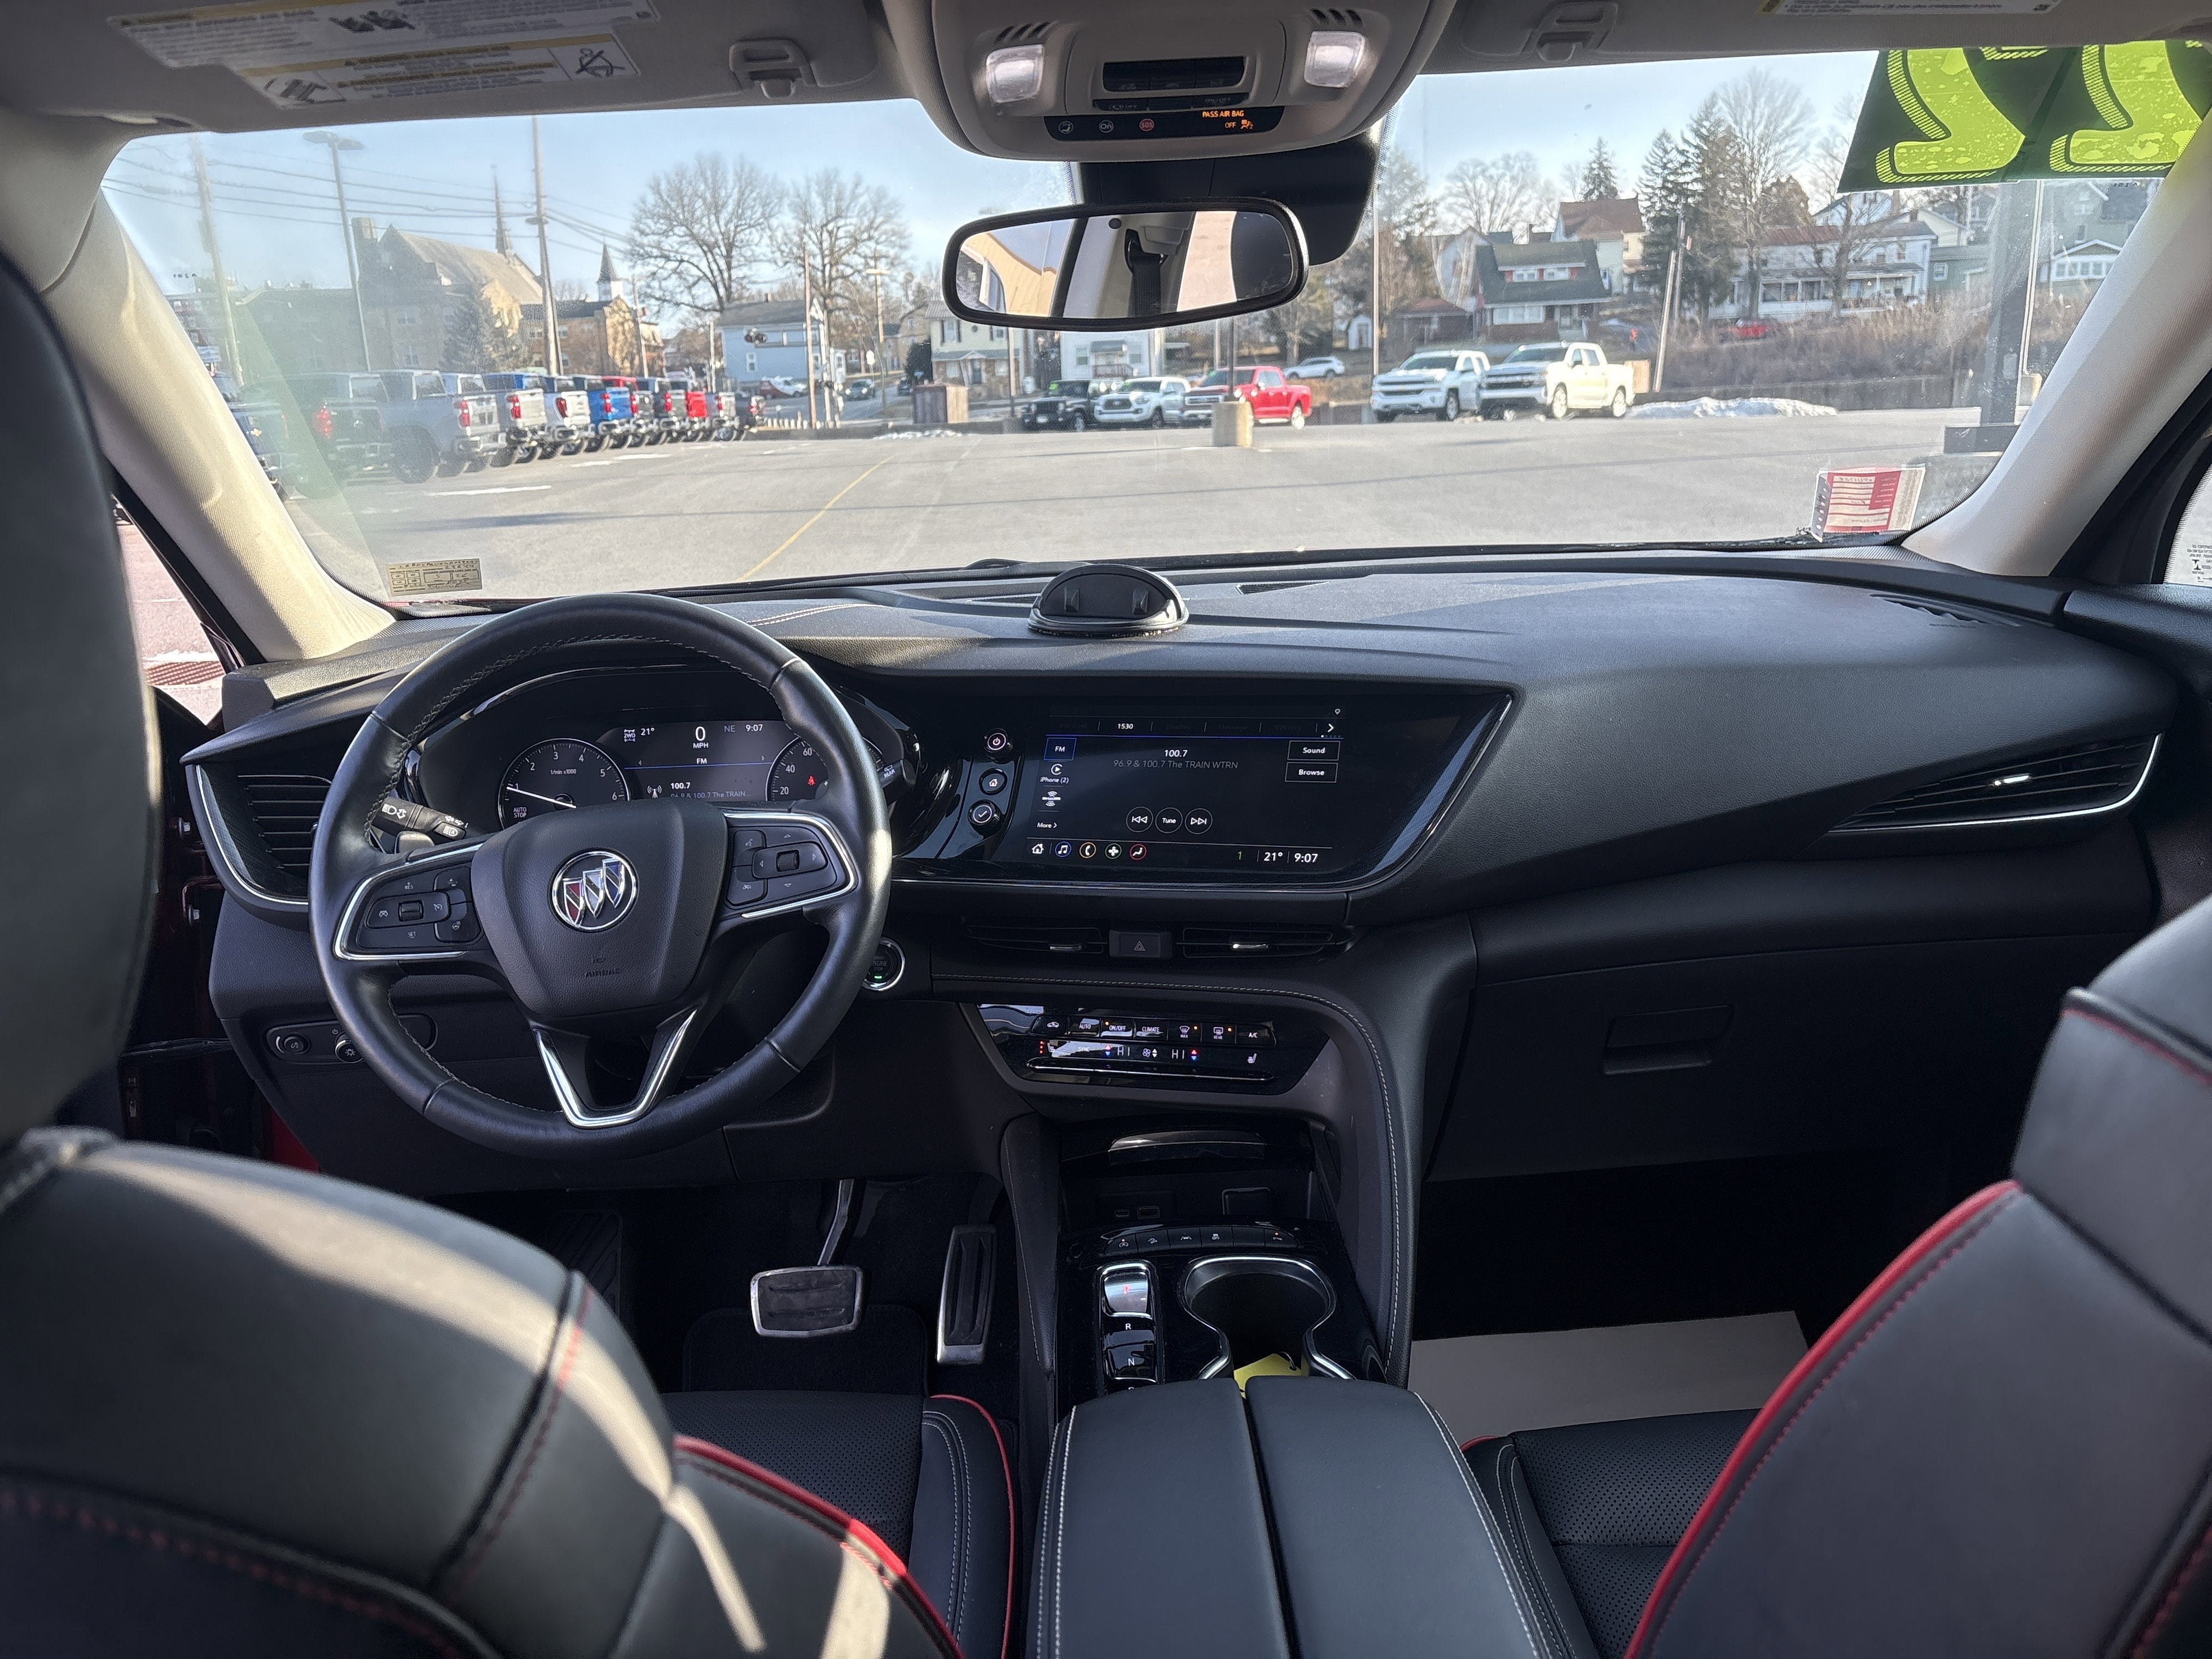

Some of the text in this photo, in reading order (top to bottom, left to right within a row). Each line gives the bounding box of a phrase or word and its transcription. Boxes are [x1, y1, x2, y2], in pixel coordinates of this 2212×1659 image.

[640, 727, 655, 736] 21°
[745, 724, 763, 732] 9:07
[695, 726, 707, 741] 0
[553, 751, 558, 760] 3
[803, 747, 812, 757] 60
[1164, 749, 1188, 758] 100.7
[578, 754, 584, 763] 4
[530, 762, 535, 771] 2
[785, 764, 795, 773] 40
[1113, 759, 1132, 768] 96.9
[1143, 760, 1165, 768] 100.7
[1167, 760, 1183, 769] The
[1185, 760, 1210, 769] TRAIN
[1212, 761, 1238, 769] WTRN
[600, 769, 606, 777] 5
[883, 769, 896, 778] REAR
[780, 786, 789, 795] 20
[611, 792, 617, 800] 6
[1238, 851, 1243, 861] 1
[1263, 851, 1283, 862] 21°
[1294, 853, 1318, 864] 9:07
[1127, 1357, 1135, 1366] N
